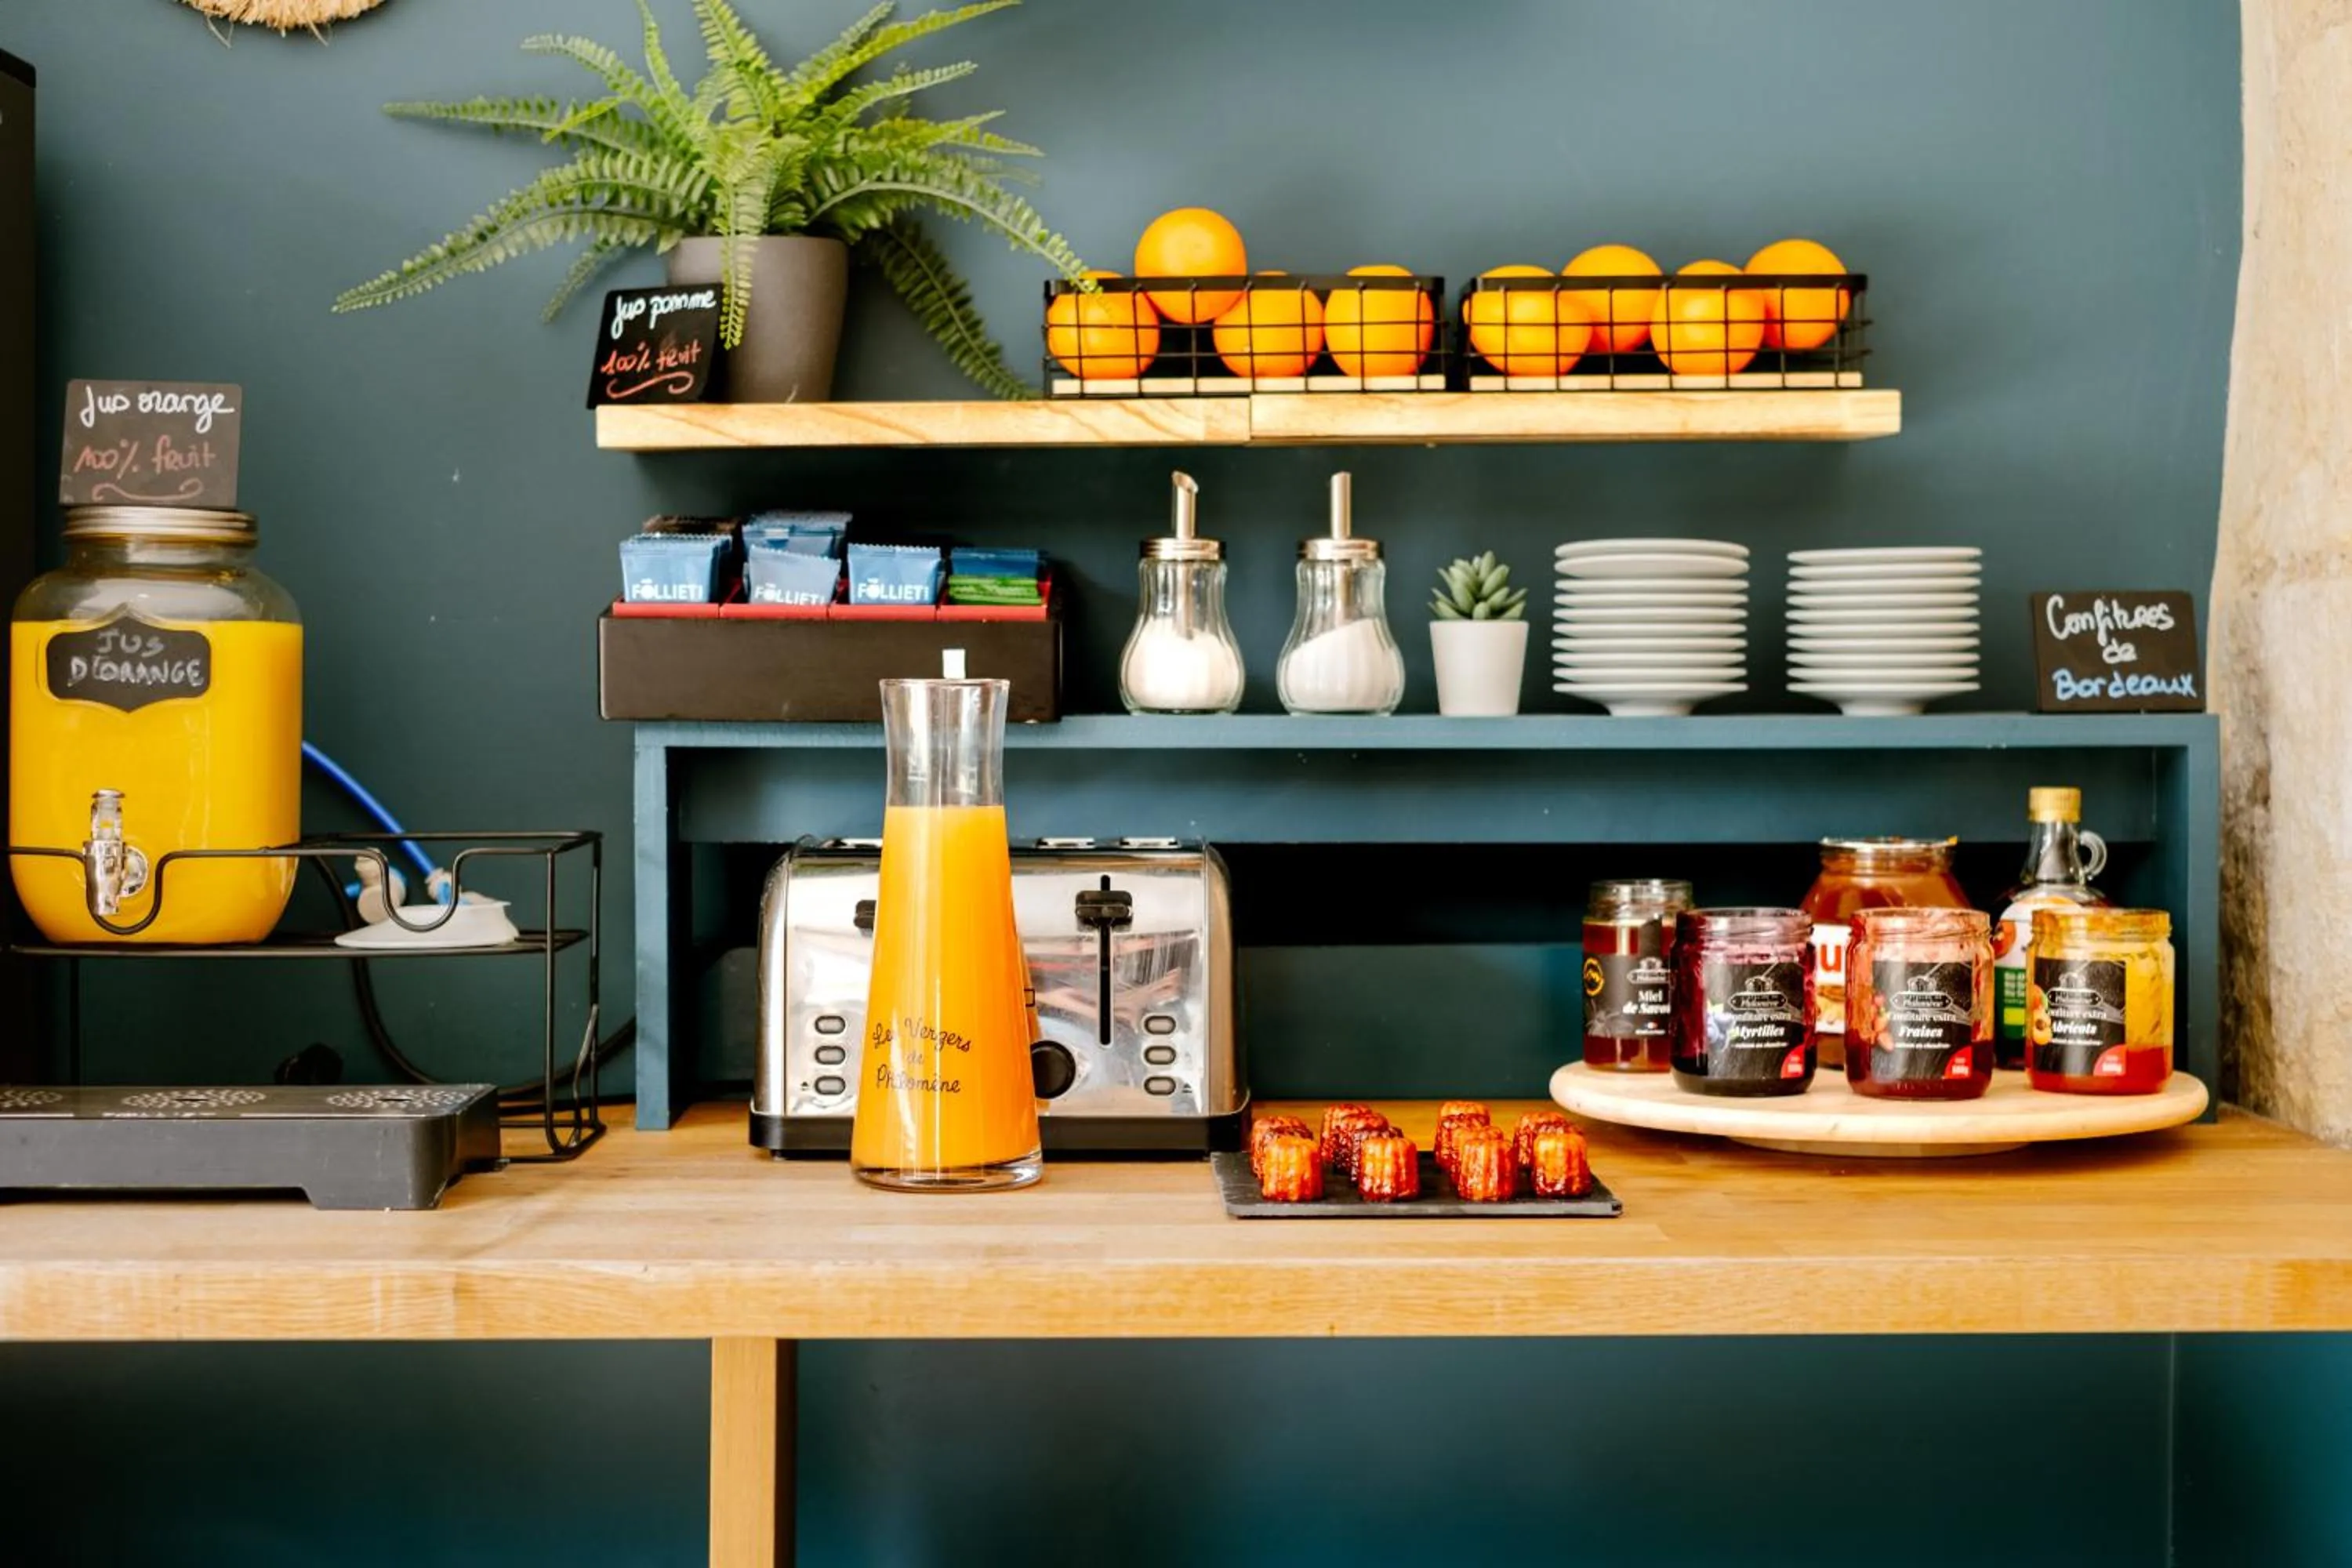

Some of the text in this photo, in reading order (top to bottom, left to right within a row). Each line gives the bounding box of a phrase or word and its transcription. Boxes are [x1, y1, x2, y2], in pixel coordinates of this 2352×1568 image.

[648, 289, 717, 329] pomme
[601, 338, 702, 376] 100% fruit
[138, 390, 235, 434] orange
[74, 434, 216, 480] 100% fruit
[96, 628, 165, 659] JUS
[2102, 637, 2138, 664] de
[2052, 668, 2198, 700] Bordeaux
[904, 1017, 972, 1053] Vergers
